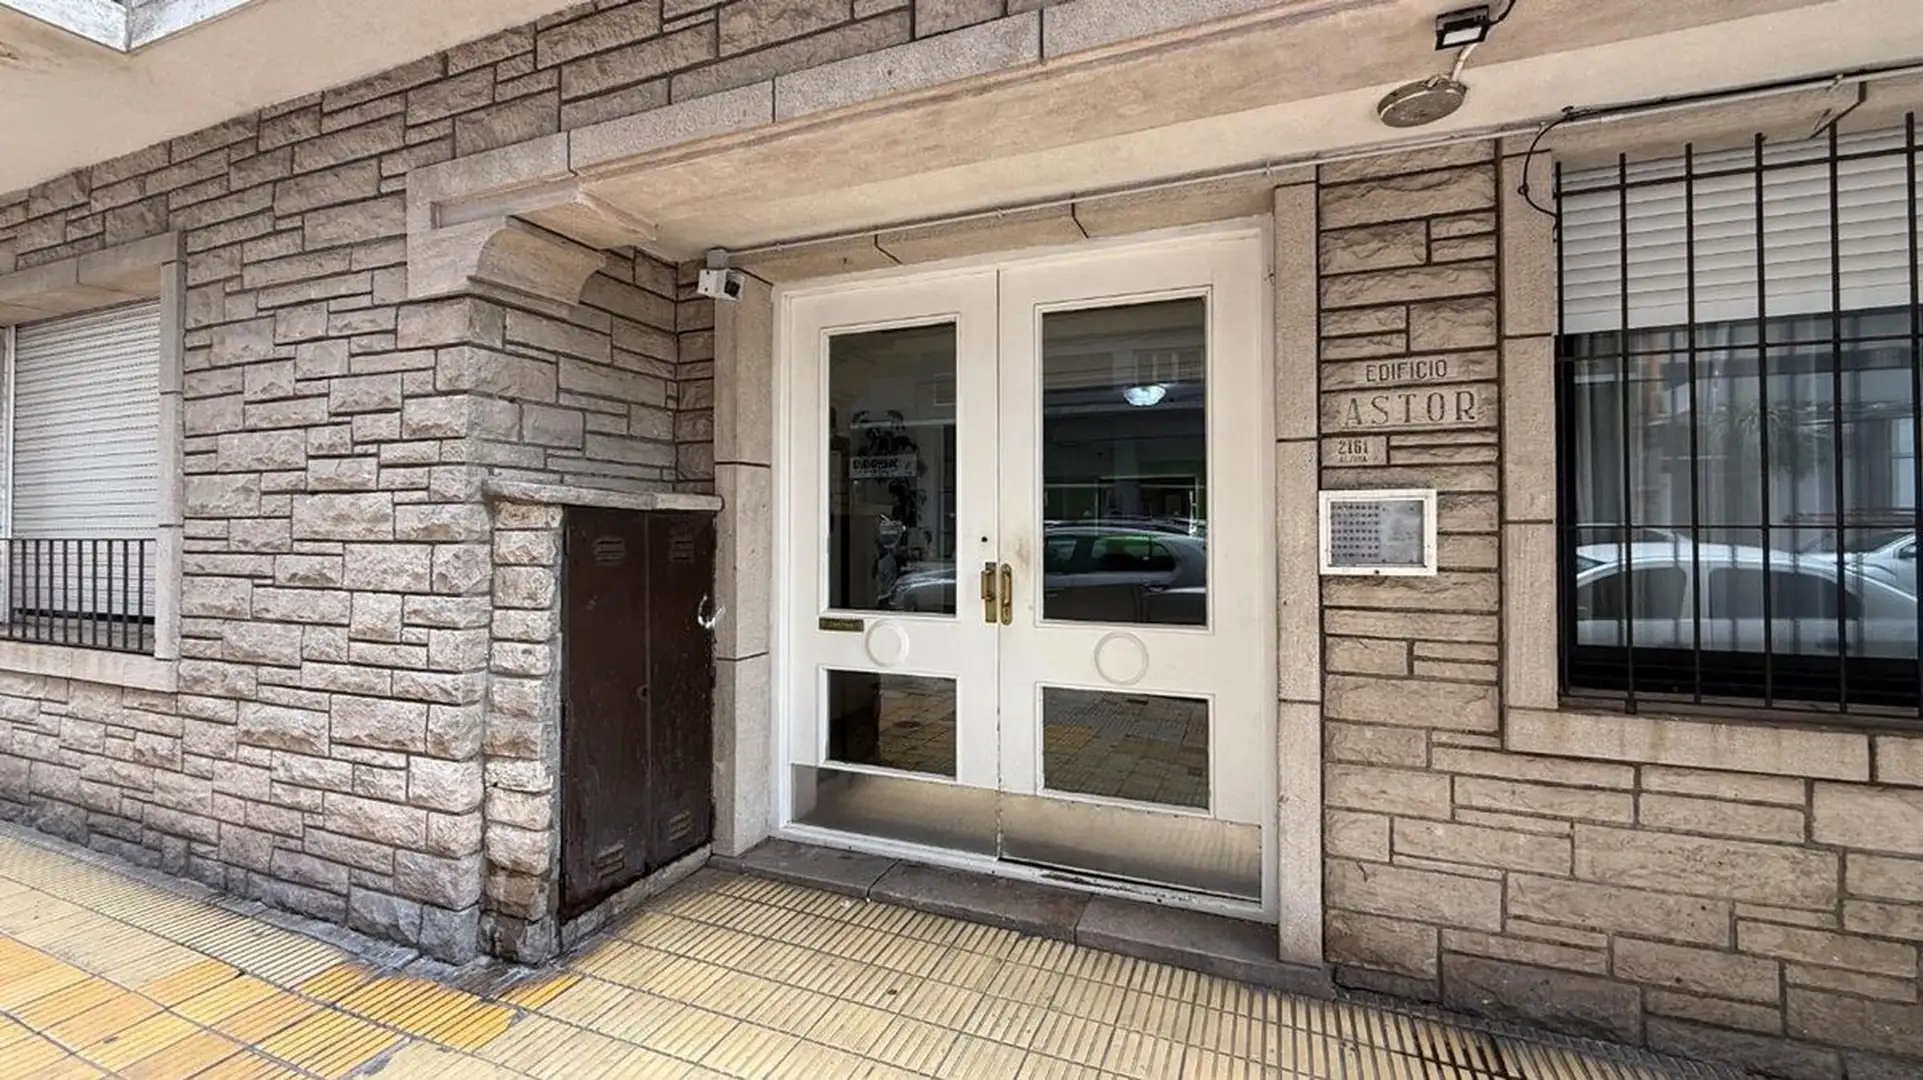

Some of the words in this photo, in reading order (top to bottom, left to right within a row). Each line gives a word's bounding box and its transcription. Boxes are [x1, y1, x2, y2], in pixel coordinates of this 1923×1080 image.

[1366, 359, 1448, 383] EDIFICIO
[1343, 389, 1476, 429] ASTOR
[1338, 439, 1369, 455] 2161
